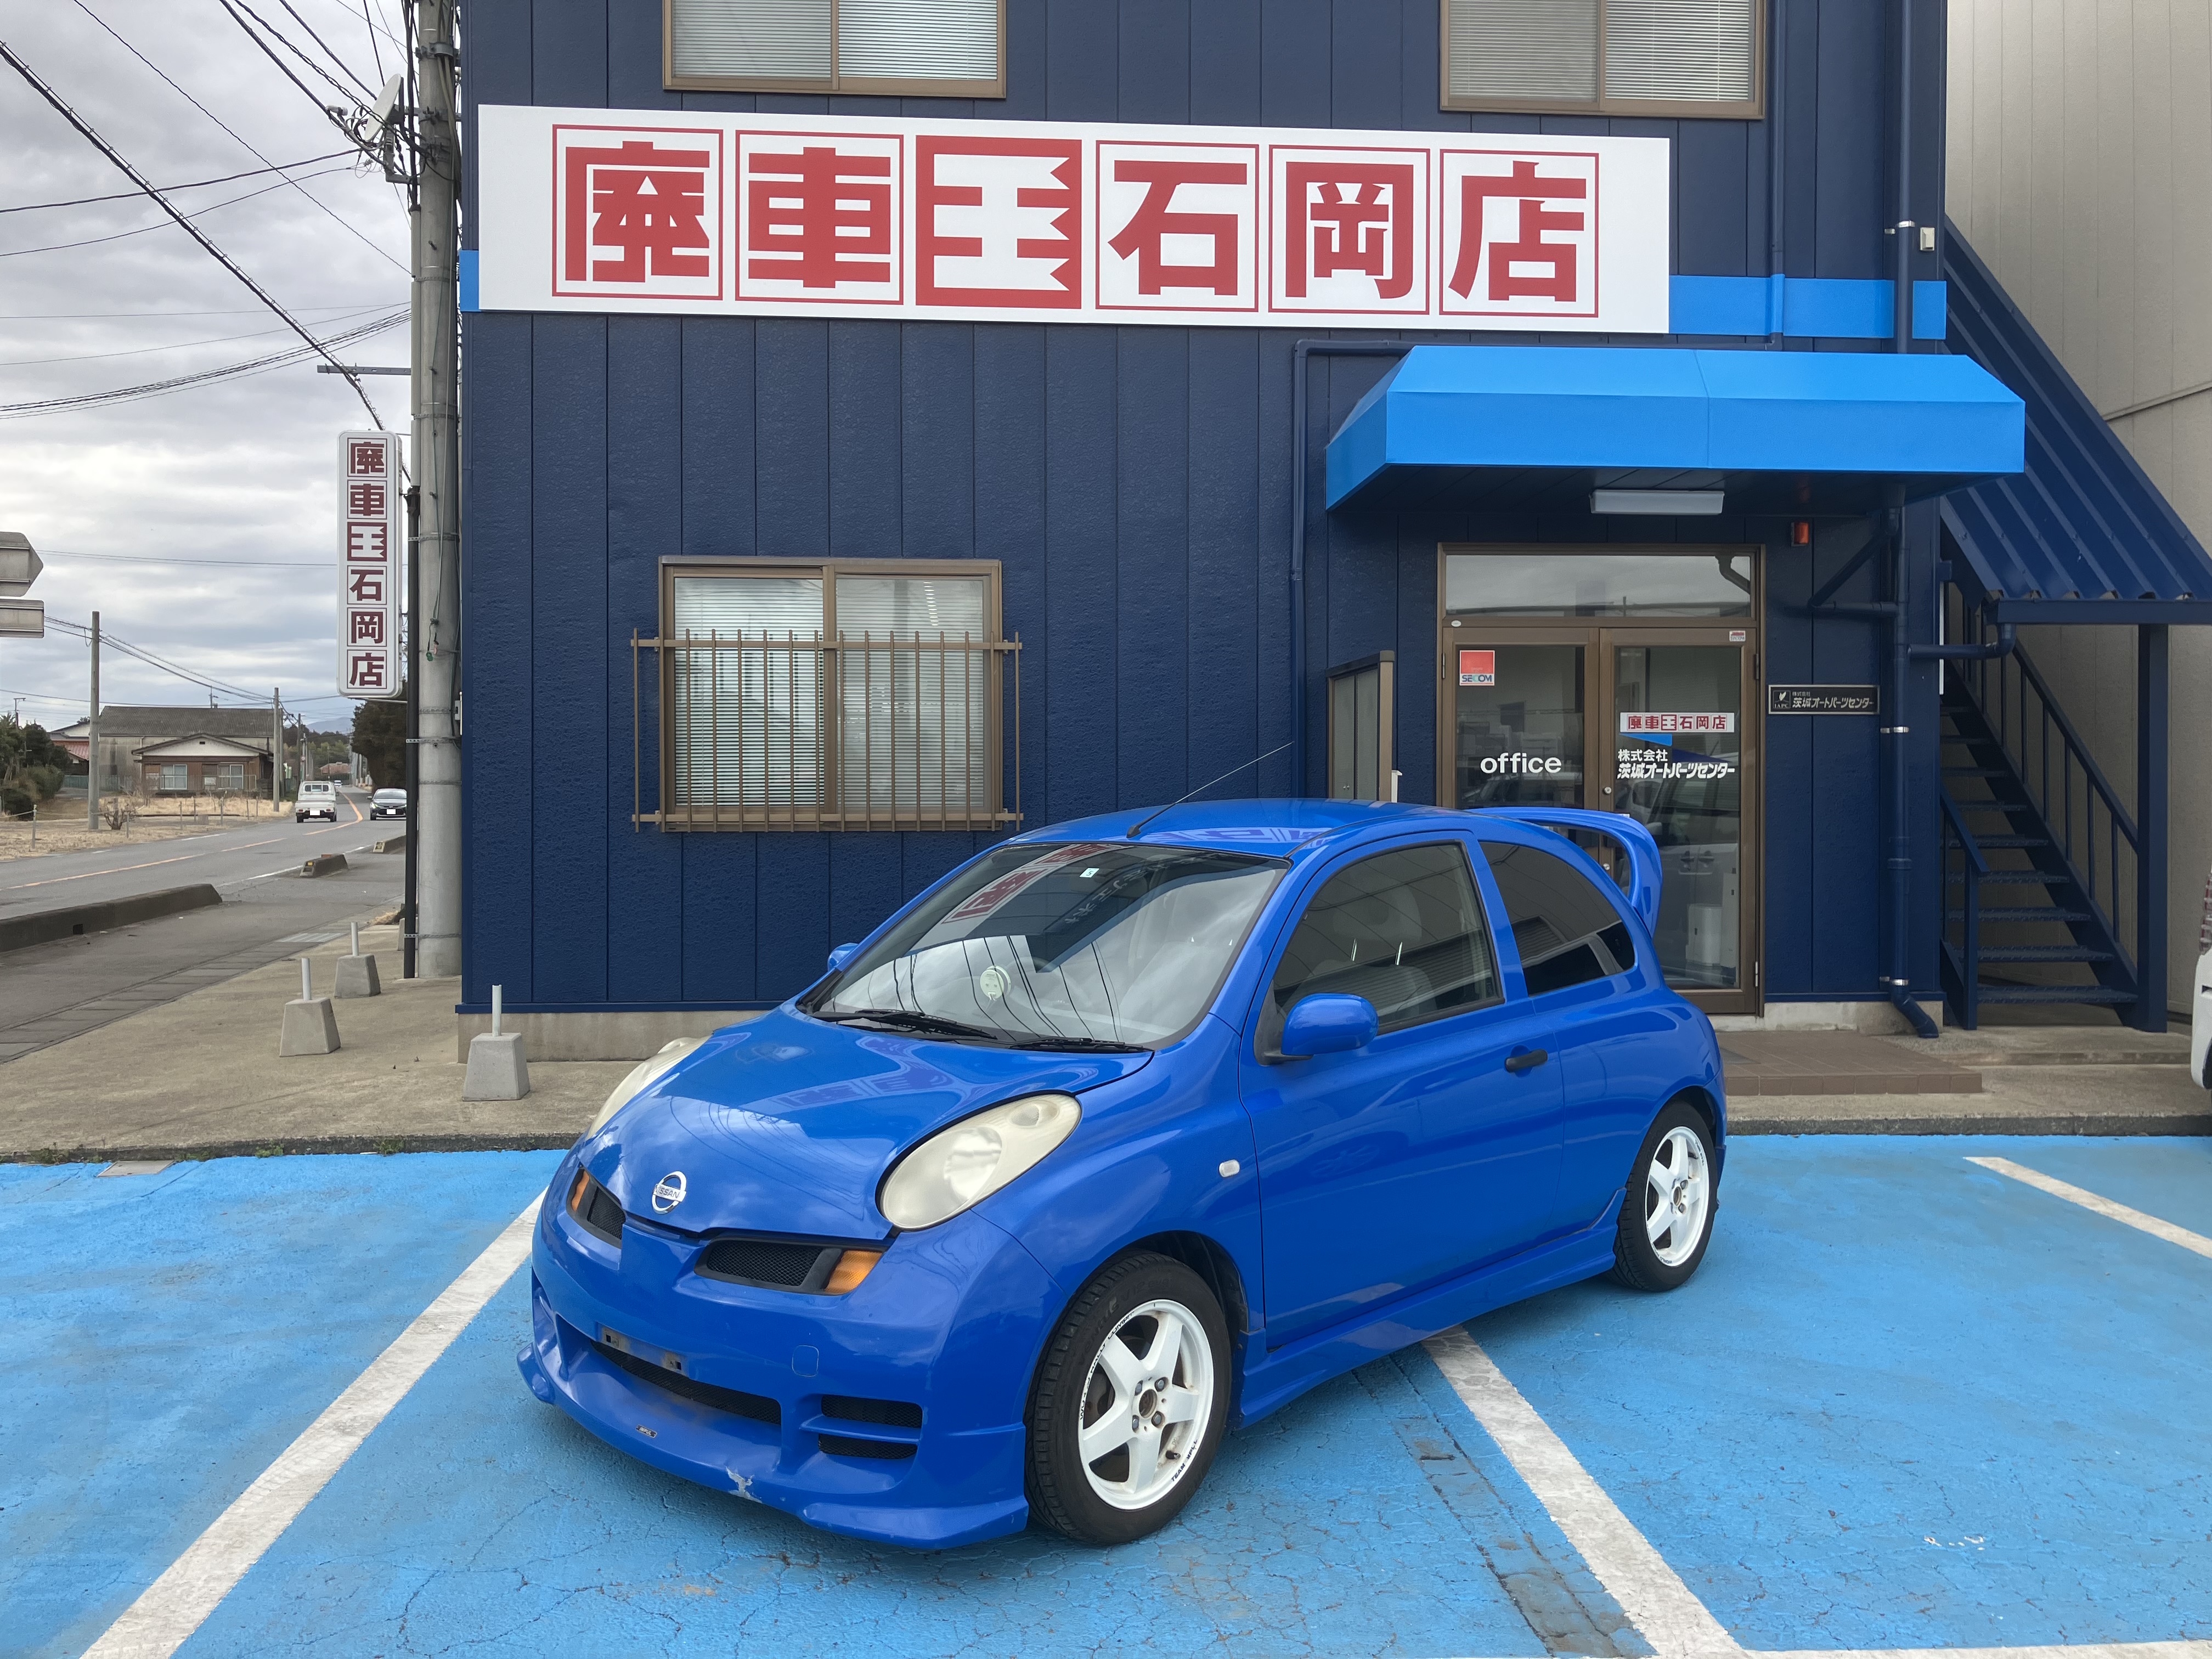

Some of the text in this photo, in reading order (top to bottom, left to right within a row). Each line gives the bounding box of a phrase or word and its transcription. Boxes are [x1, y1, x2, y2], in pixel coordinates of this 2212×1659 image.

[564, 136, 1588, 311] 廃車王石岡店
[347, 441, 387, 687] 廃車王石岡店
[1792, 697, 1874, 708] 茨城オートパーツセンター
[1480, 752, 1562, 774] office
[1618, 749, 1668, 762] 株式会社
[1617, 762, 1735, 779] 茨城オートパーツセンター
[654, 1186, 680, 1199] NISSAN
[1171, 1463, 1186, 1482] TEAM
